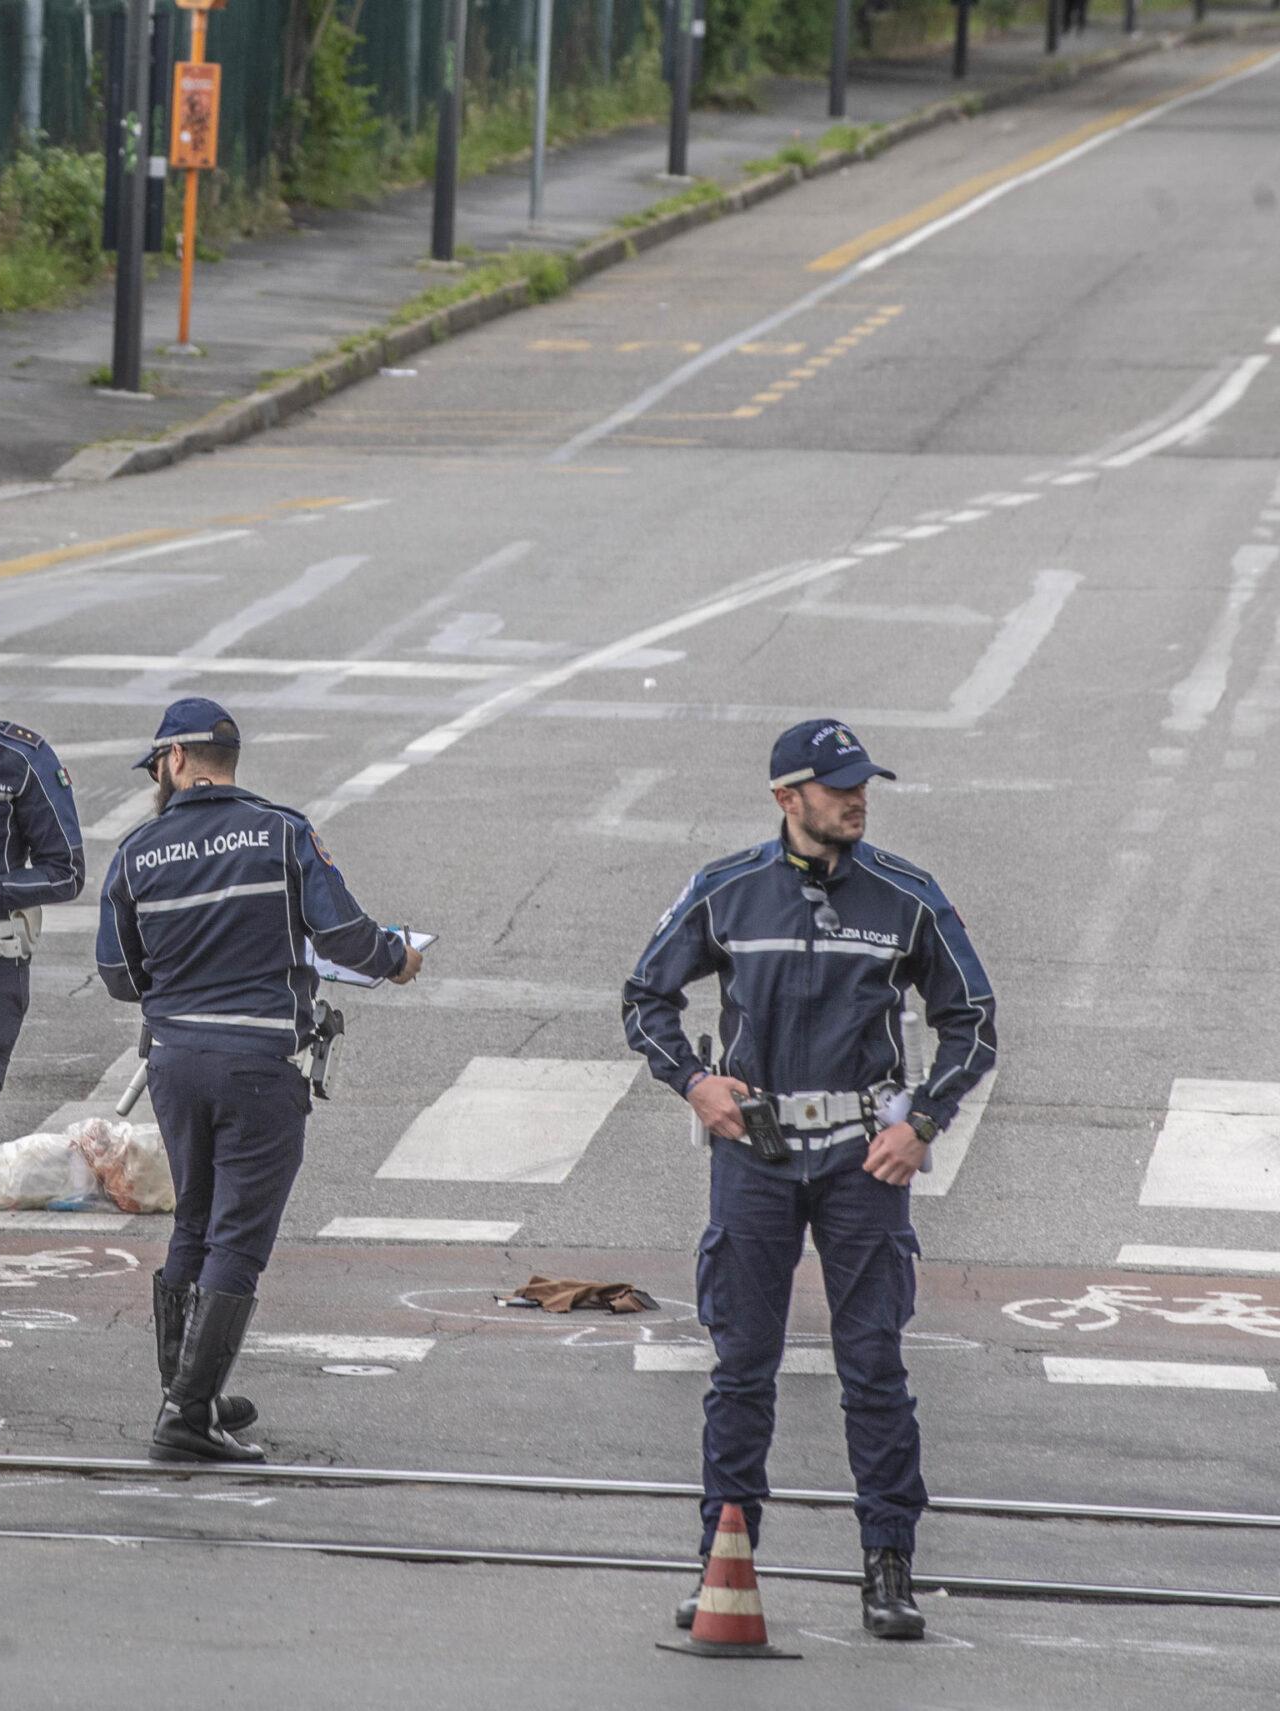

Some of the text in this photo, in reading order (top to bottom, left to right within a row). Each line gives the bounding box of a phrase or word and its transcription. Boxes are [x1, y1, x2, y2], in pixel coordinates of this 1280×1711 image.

[135, 830, 270, 873] POLIZIA LOCALE
[862, 929, 899, 946] LOCALE
